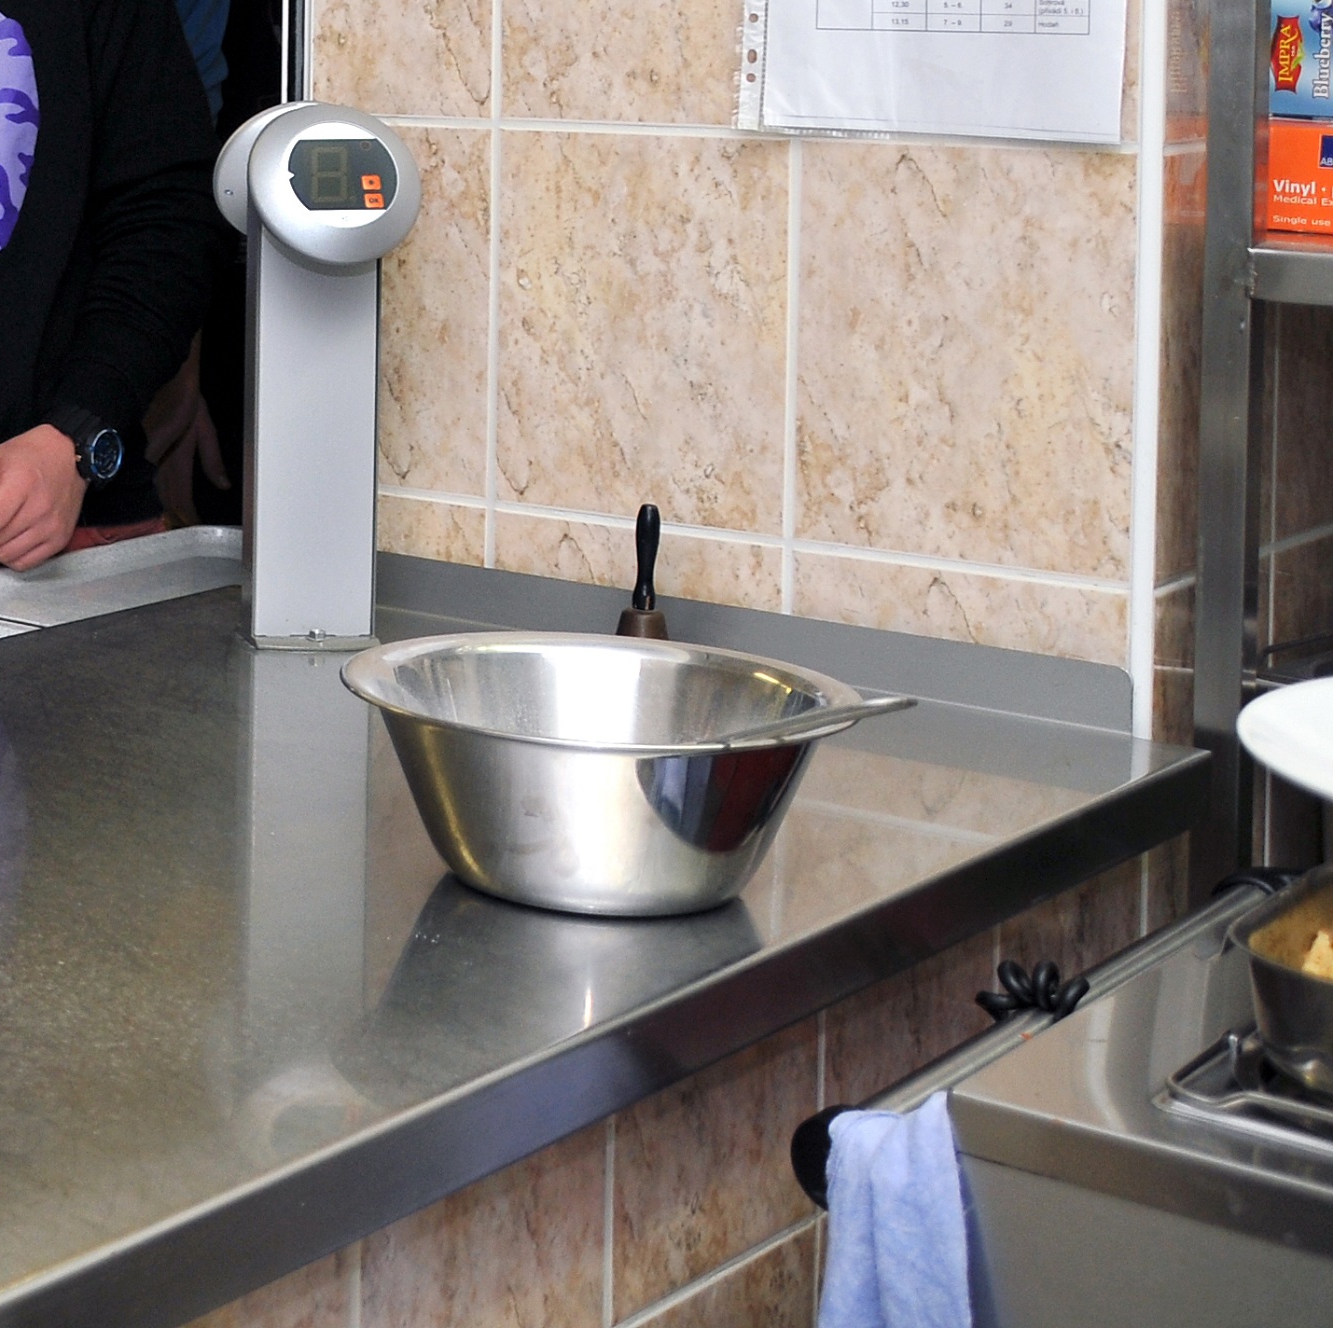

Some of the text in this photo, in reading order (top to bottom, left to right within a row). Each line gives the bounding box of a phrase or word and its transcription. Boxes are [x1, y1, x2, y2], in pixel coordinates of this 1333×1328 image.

[1278, 24, 1298, 82] IMPRA
[1312, 12, 1333, 98] Blueberry
[1274, 179, 1316, 196] Vinyl
[1274, 194, 1316, 204] Medical
[1274, 214, 1307, 225] Single
